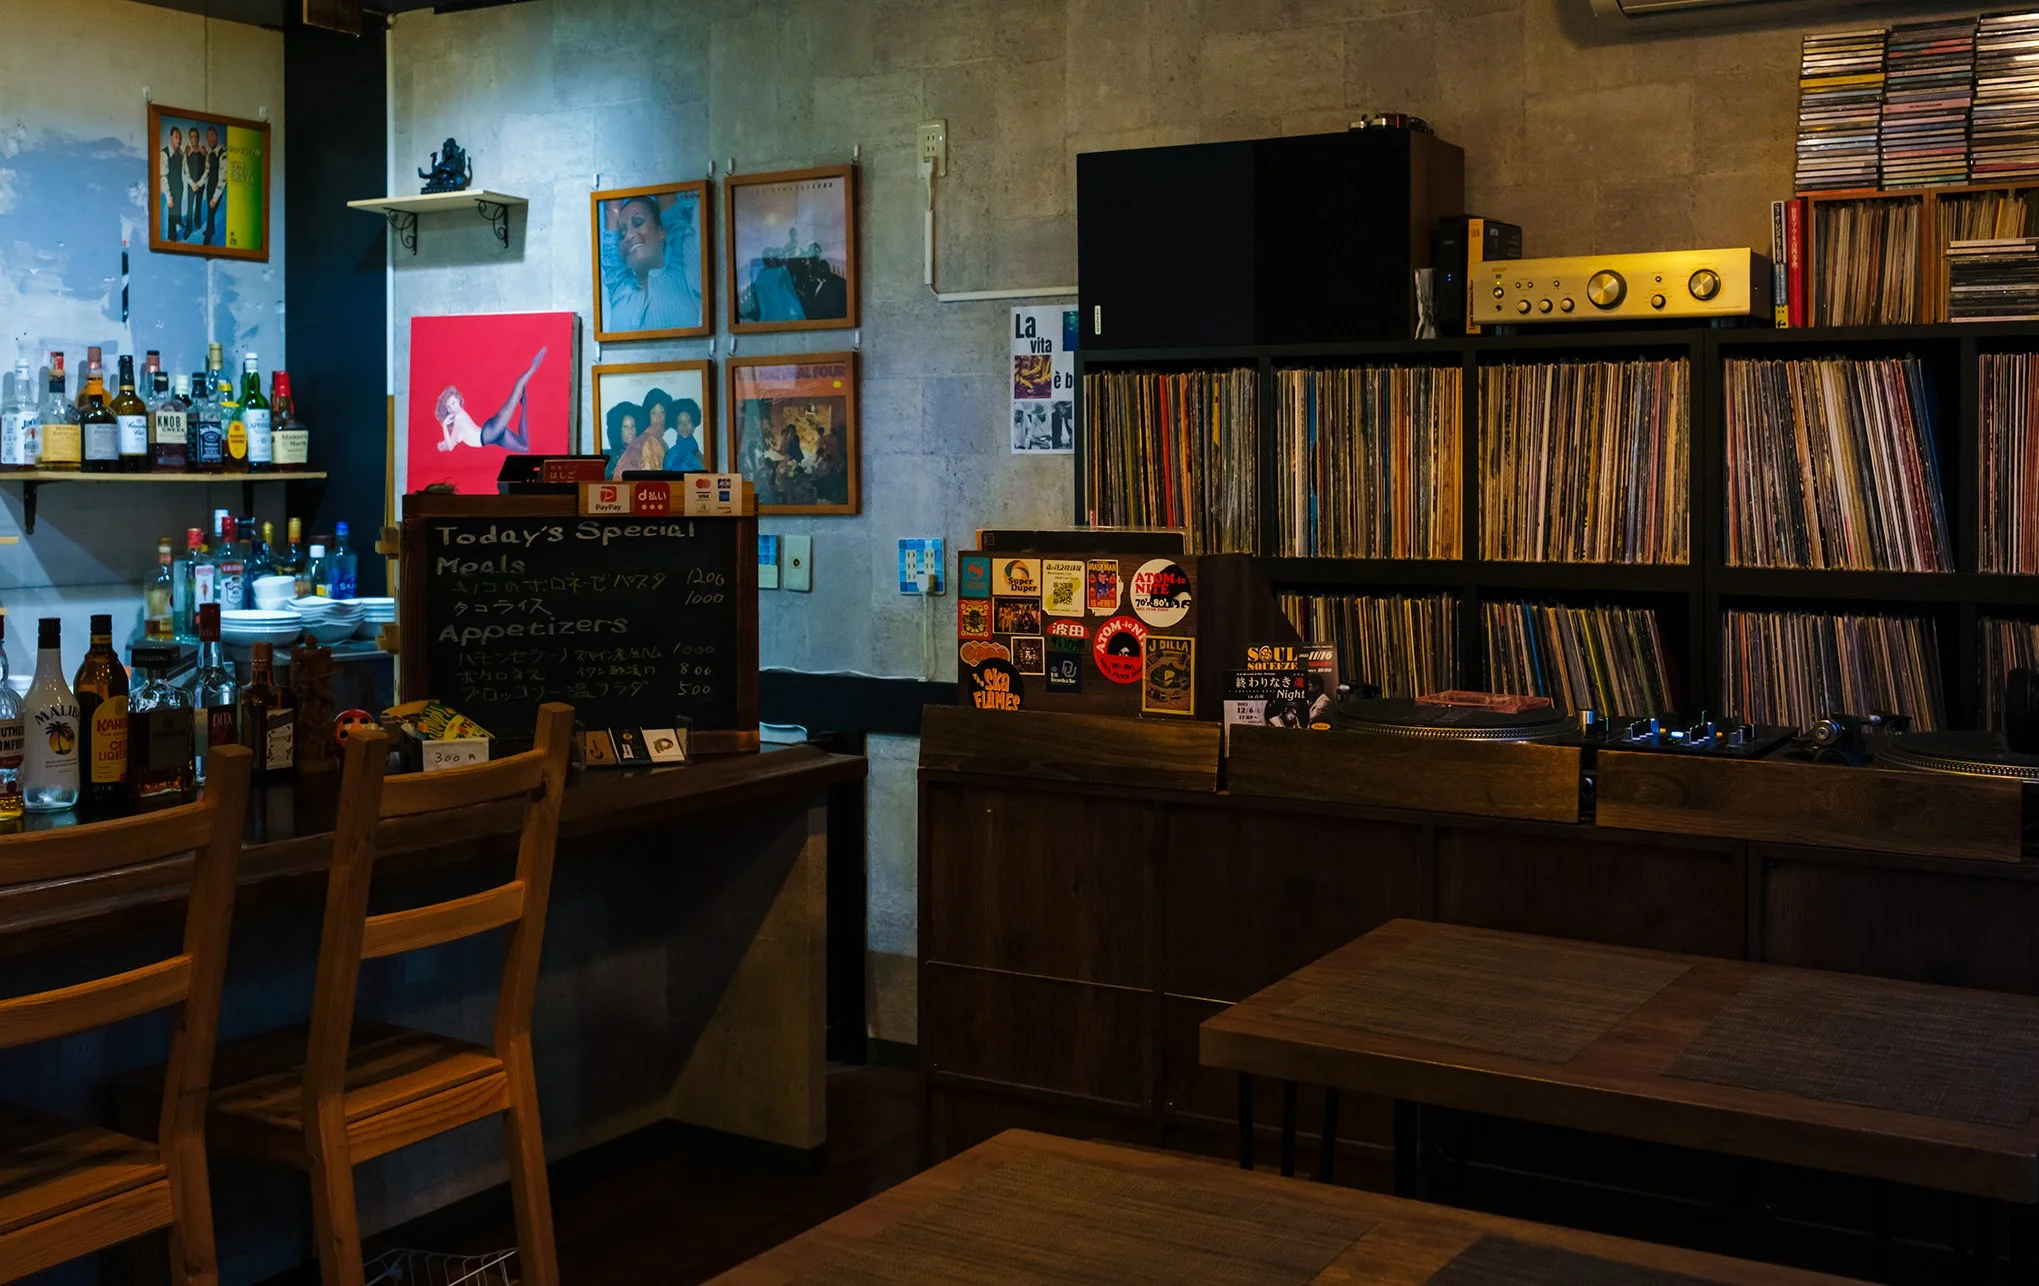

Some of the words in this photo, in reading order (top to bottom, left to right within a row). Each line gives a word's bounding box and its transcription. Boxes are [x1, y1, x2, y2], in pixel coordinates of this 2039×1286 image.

[1016, 313, 1036, 338] La
[1031, 337, 1052, 353] vita
[1054, 371, 1061, 389] è
[157, 415, 181, 427] KNOB
[638, 489, 665, 501] d払い
[595, 504, 622, 513] PayPay
[435, 523, 565, 549] Today's
[575, 519, 695, 547] Special
[436, 553, 526, 576] Meals
[1008, 577, 1033, 586] Super
[1011, 583, 1038, 593] Duper
[1135, 583, 1170, 595] NITE
[453, 596, 553, 616] タコライス
[684, 590, 725, 606] 1000
[437, 615, 629, 648] Appetizers
[672, 641, 715, 657] 1000
[1149, 640, 1157, 652] J
[1159, 640, 1188, 653] DILLA
[1247, 645, 1298, 662] SOUL
[1308, 651, 1333, 660] 11/16
[679, 661, 713, 677] 800
[1247, 662, 1298, 671] SQUEEZE
[677, 680, 712, 697] 500
[1277, 689, 1305, 701] Night
[213, 713, 233, 727] DITA
[435, 752, 460, 763] 300
